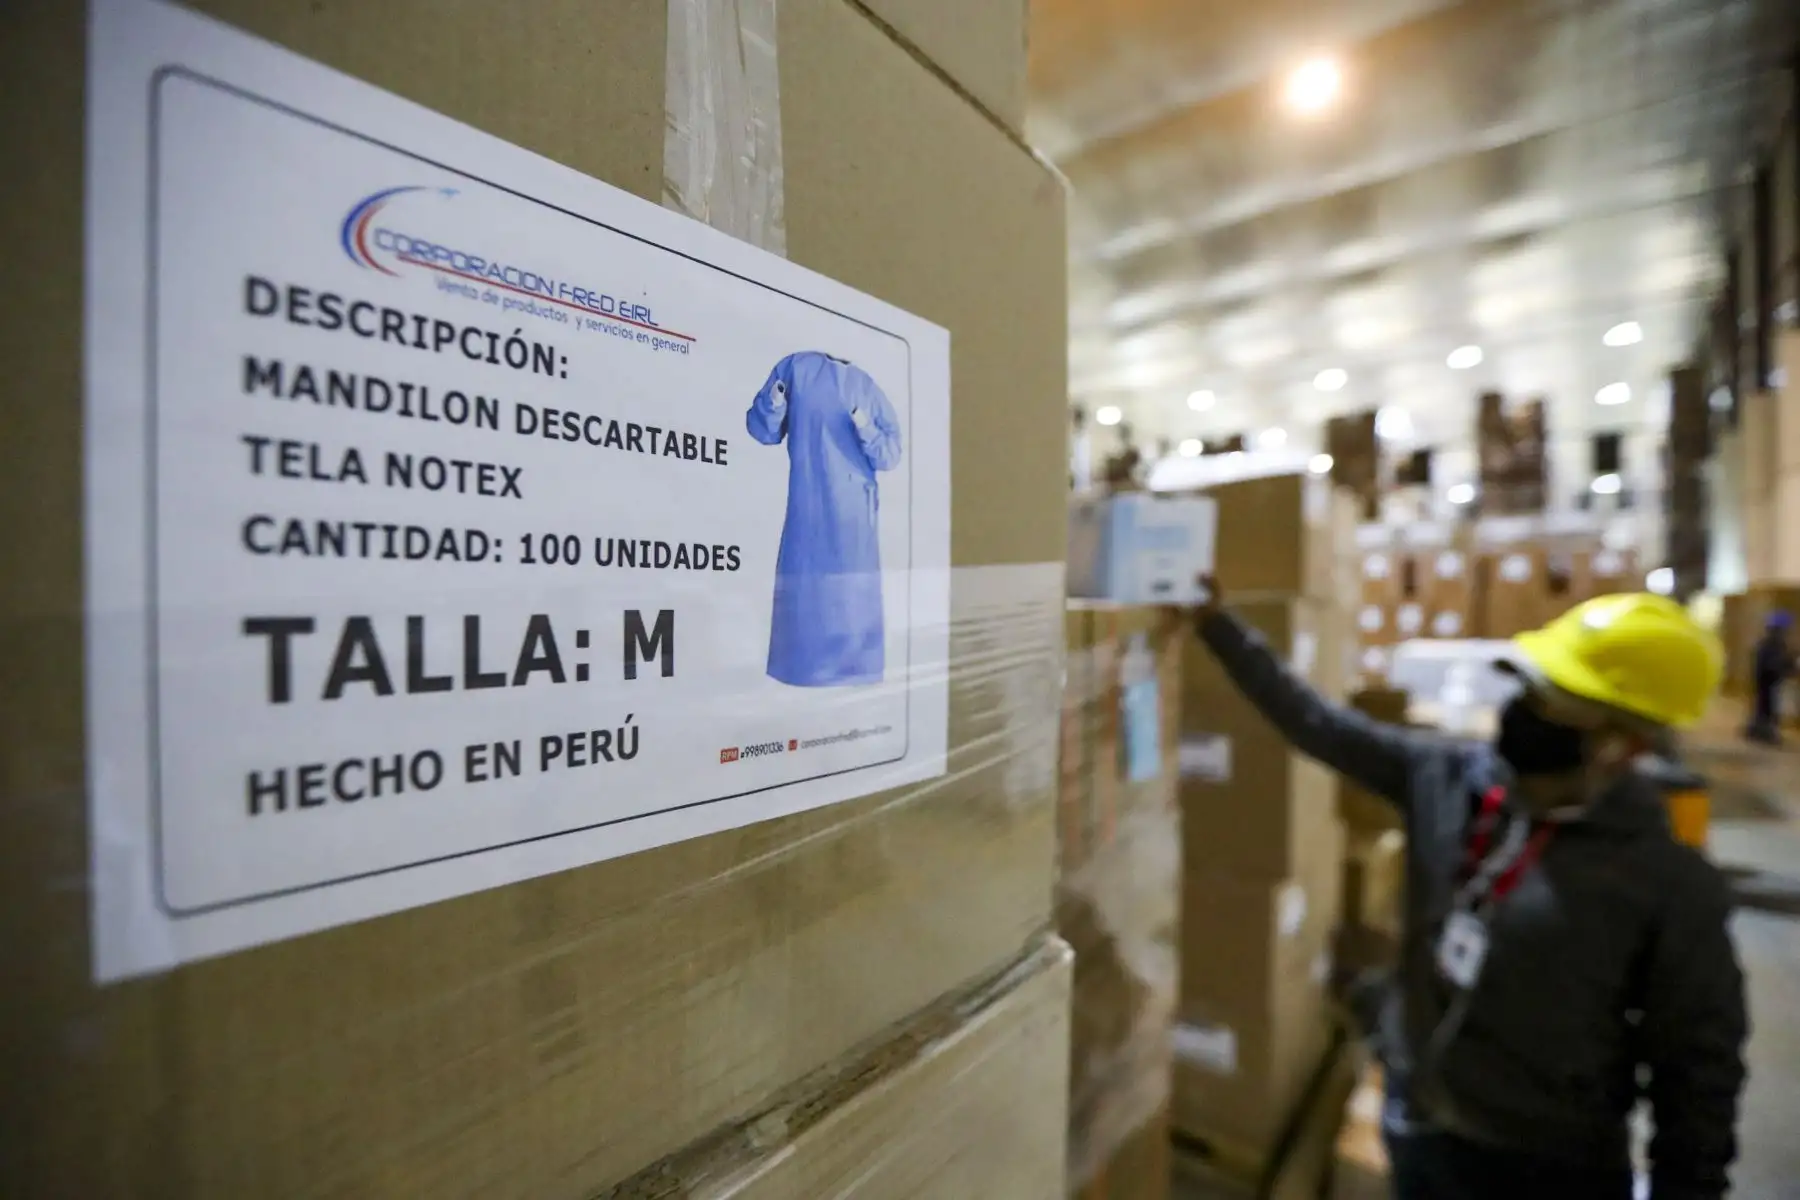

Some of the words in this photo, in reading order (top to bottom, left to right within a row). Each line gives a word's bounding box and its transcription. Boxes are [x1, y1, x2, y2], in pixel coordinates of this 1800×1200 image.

[374, 227, 554, 298] CORPORACION
[559, 282, 615, 313] FRED
[619, 300, 659, 326] EIRL
[434, 275, 479, 300] Venta
[481, 287, 499, 305] de
[502, 295, 568, 324] productos
[575, 315, 583, 331] y
[585, 317, 634, 341] servicios
[636, 331, 650, 344] en
[651, 335, 690, 355] general
[244, 274, 570, 379] DESCRIPCIÓN:
[241, 355, 501, 431] MANDILON
[514, 403, 729, 467] DESCARTABLE
[241, 435, 369, 486] TELA
[384, 451, 524, 499] NOTEX
[241, 514, 503, 563] CANTIDAD:
[519, 534, 582, 566] 100
[594, 537, 742, 572] UNIDADES
[241, 615, 590, 704] TALLA:
[623, 609, 675, 681] M
[246, 749, 444, 816] HECHO
[464, 739, 521, 784] EN
[539, 713, 640, 772] PERÚ
